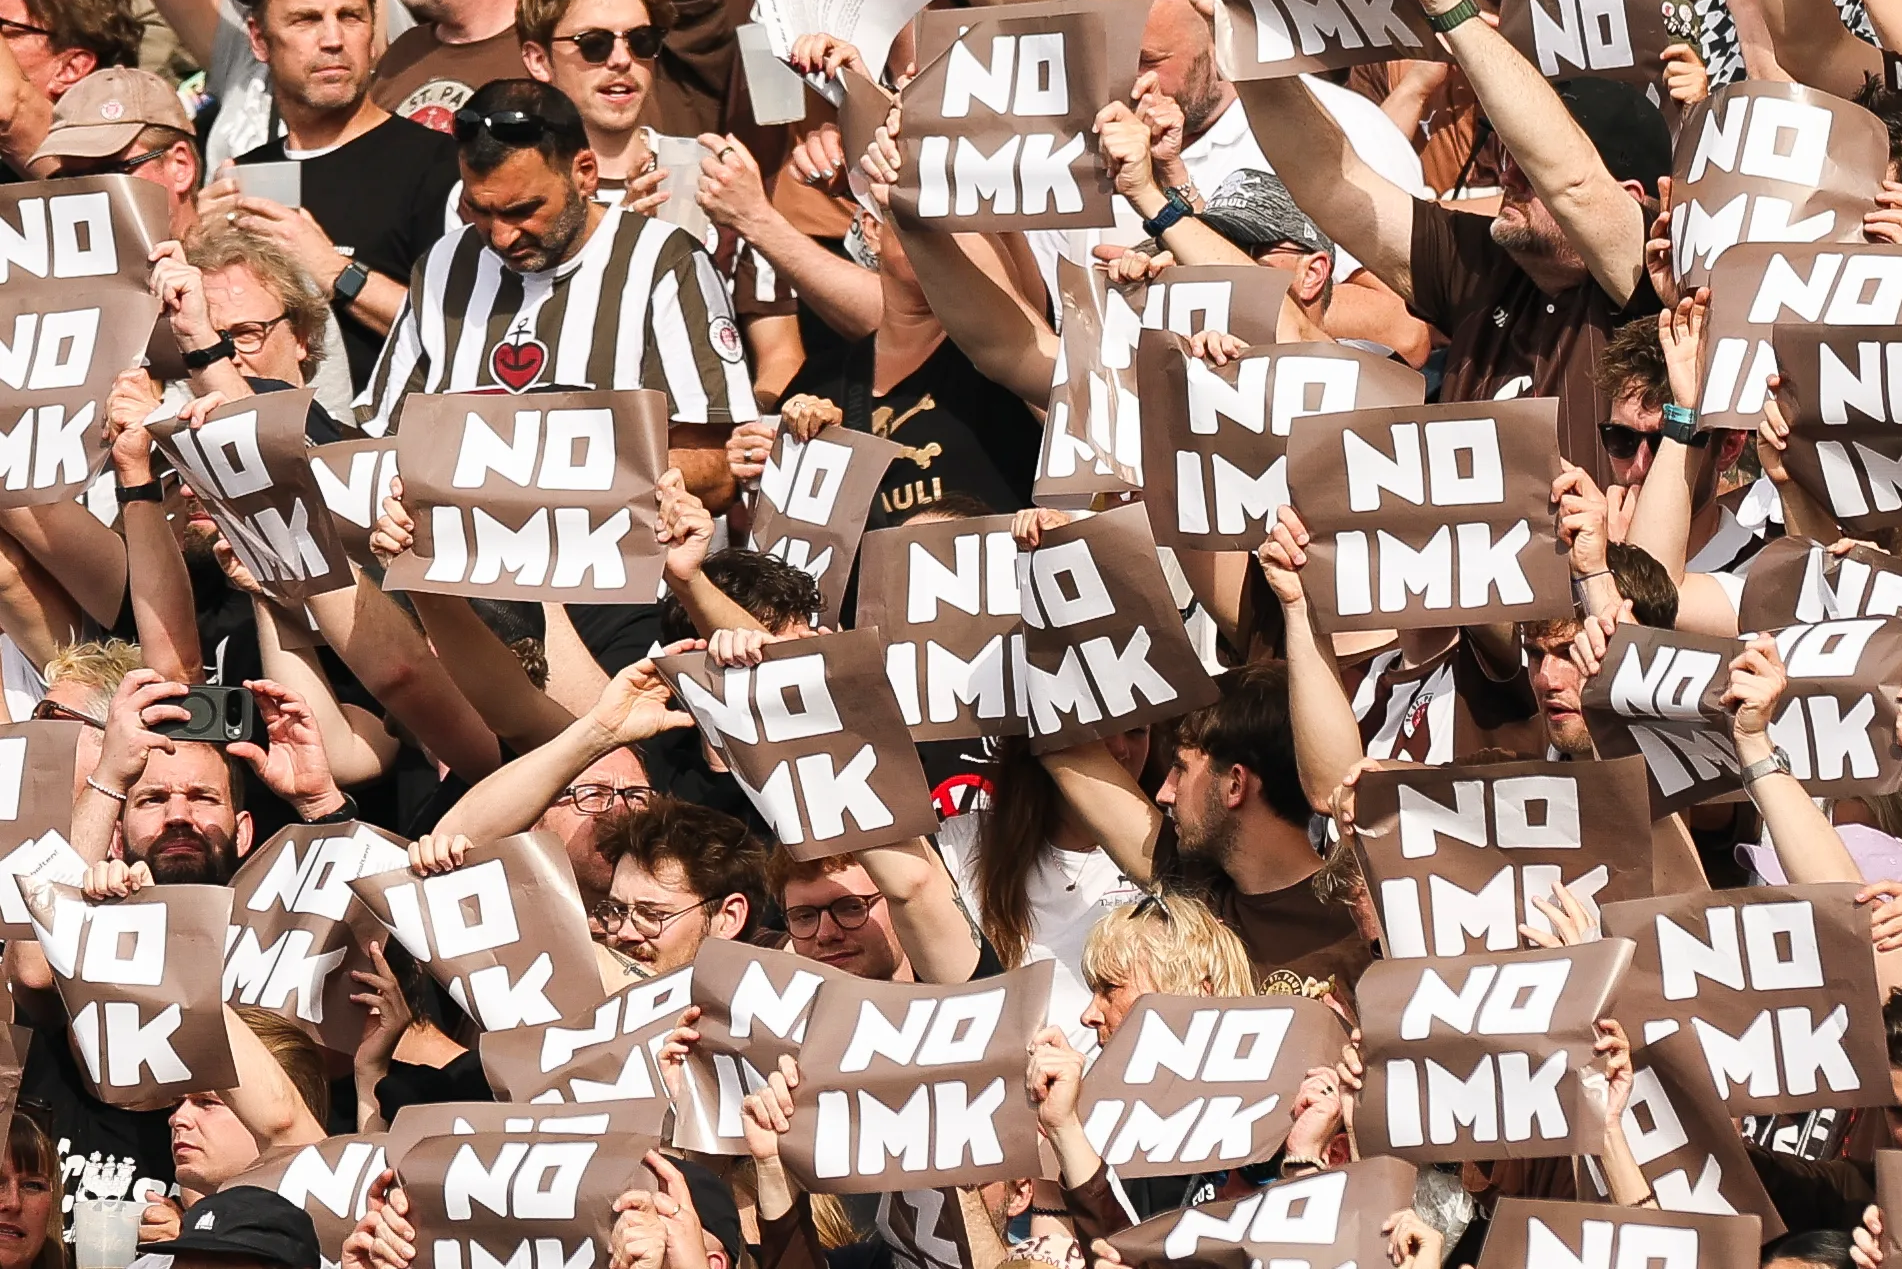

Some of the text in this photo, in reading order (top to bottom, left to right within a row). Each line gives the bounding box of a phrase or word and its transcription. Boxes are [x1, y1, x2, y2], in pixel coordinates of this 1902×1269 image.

[942, 32, 1071, 118] NO
[919, 132, 1084, 218] IMK
[1688, 94, 1832, 187] NO
[1186, 357, 1361, 435] NO
[452, 407, 614, 491] NO
[1344, 419, 1504, 513] NO
[425, 506, 634, 590] IMK
[1334, 518, 1533, 616] IMK
[678, 651, 844, 748] NO
[1611, 644, 1723, 721] NO
[1397, 774, 1582, 859] NO
[1655, 900, 1824, 1000] NO
[841, 987, 1006, 1074] NO
[1400, 958, 1571, 1040] NO
[1124, 1006, 1295, 1084] NO
[814, 1076, 1006, 1180] IMK
[1386, 1049, 1569, 1148] IMK
[444, 1142, 598, 1221] NO
[1166, 1172, 1348, 1258] NO
